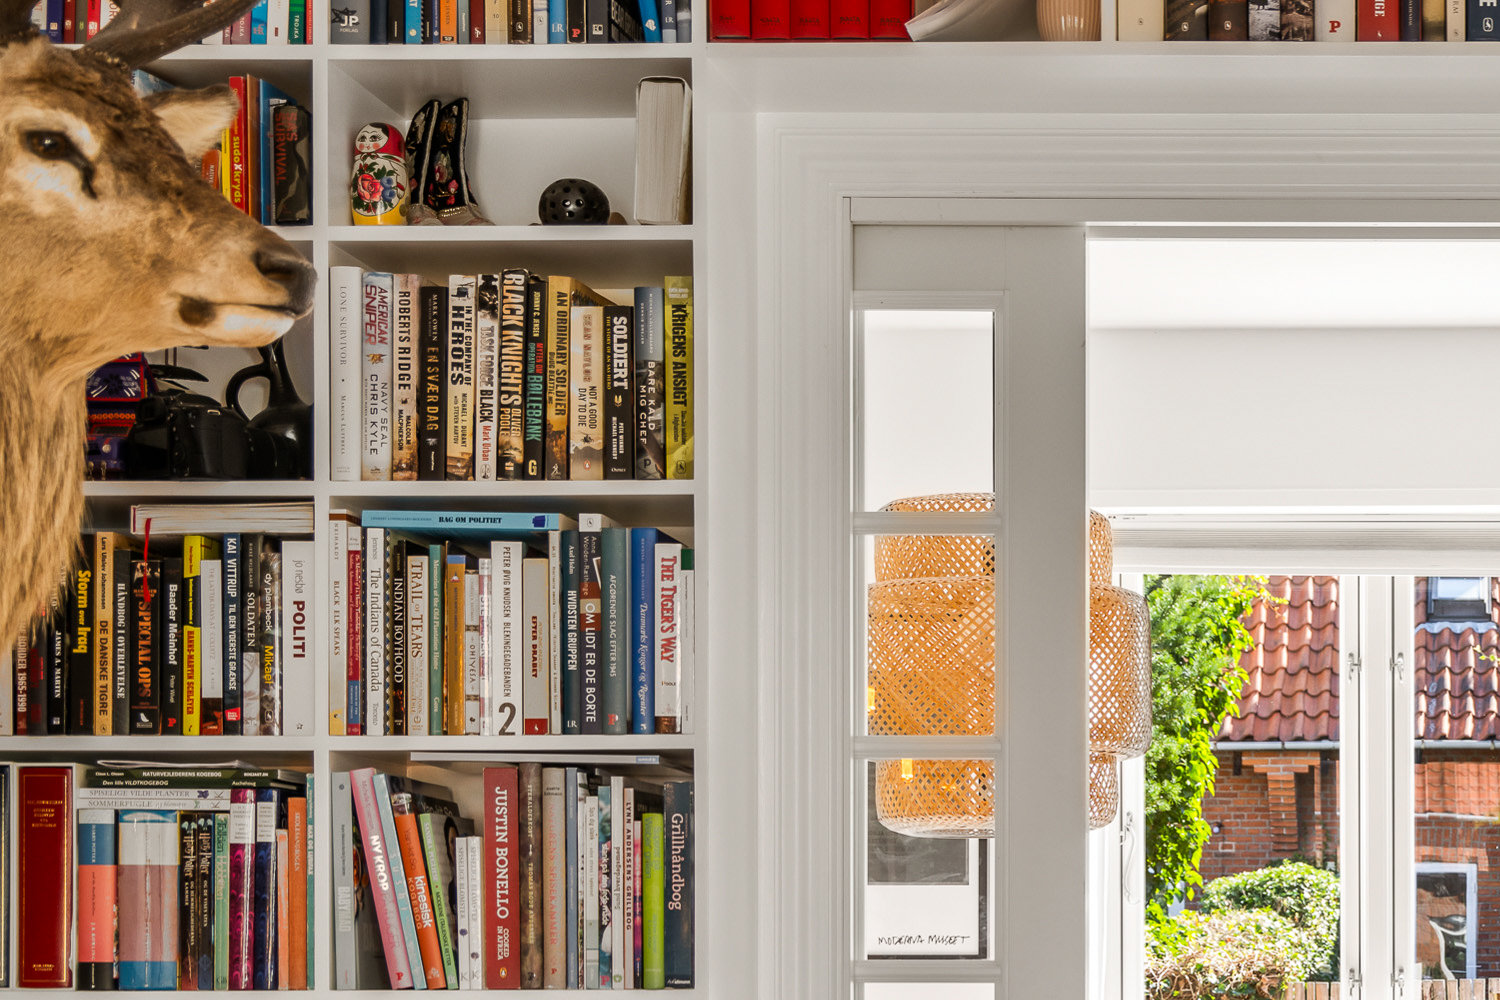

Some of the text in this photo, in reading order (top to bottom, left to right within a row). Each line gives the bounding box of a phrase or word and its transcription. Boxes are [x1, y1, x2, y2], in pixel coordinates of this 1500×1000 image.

[365, 285, 377, 345] SNIPER
[378, 287, 389, 345] AMERICAN
[399, 291, 411, 390] ROBERTS RIDGE
[451, 305, 464, 385] HEROES
[500, 274, 525, 405] BLACK KNIGHTS
[555, 292, 567, 415] AN ORDINARY SOLDIER
[671, 305, 688, 407] KRIGENS ANSIGT
[168, 584, 178, 665] Baader Meinhof
[247, 592, 255, 647] SOLDATEN
[293, 600, 305, 658] POLITI
[370, 568, 382, 692] The Indians of Canada
[394, 578, 404, 683] INDIAN BOYHOOD
[411, 562, 423, 658] TRAIL TEARS
[660, 556, 677, 663] THE TIGER'S WAY
[99, 620, 108, 716] DE DANSKE TIGRE
[264, 645, 274, 684] Mikael
[585, 603, 595, 722] OM LIDT ER DE BORTE
[495, 787, 509, 919] JUSTIN BONELLO
[669, 813, 684, 910] Grillhåndbog
